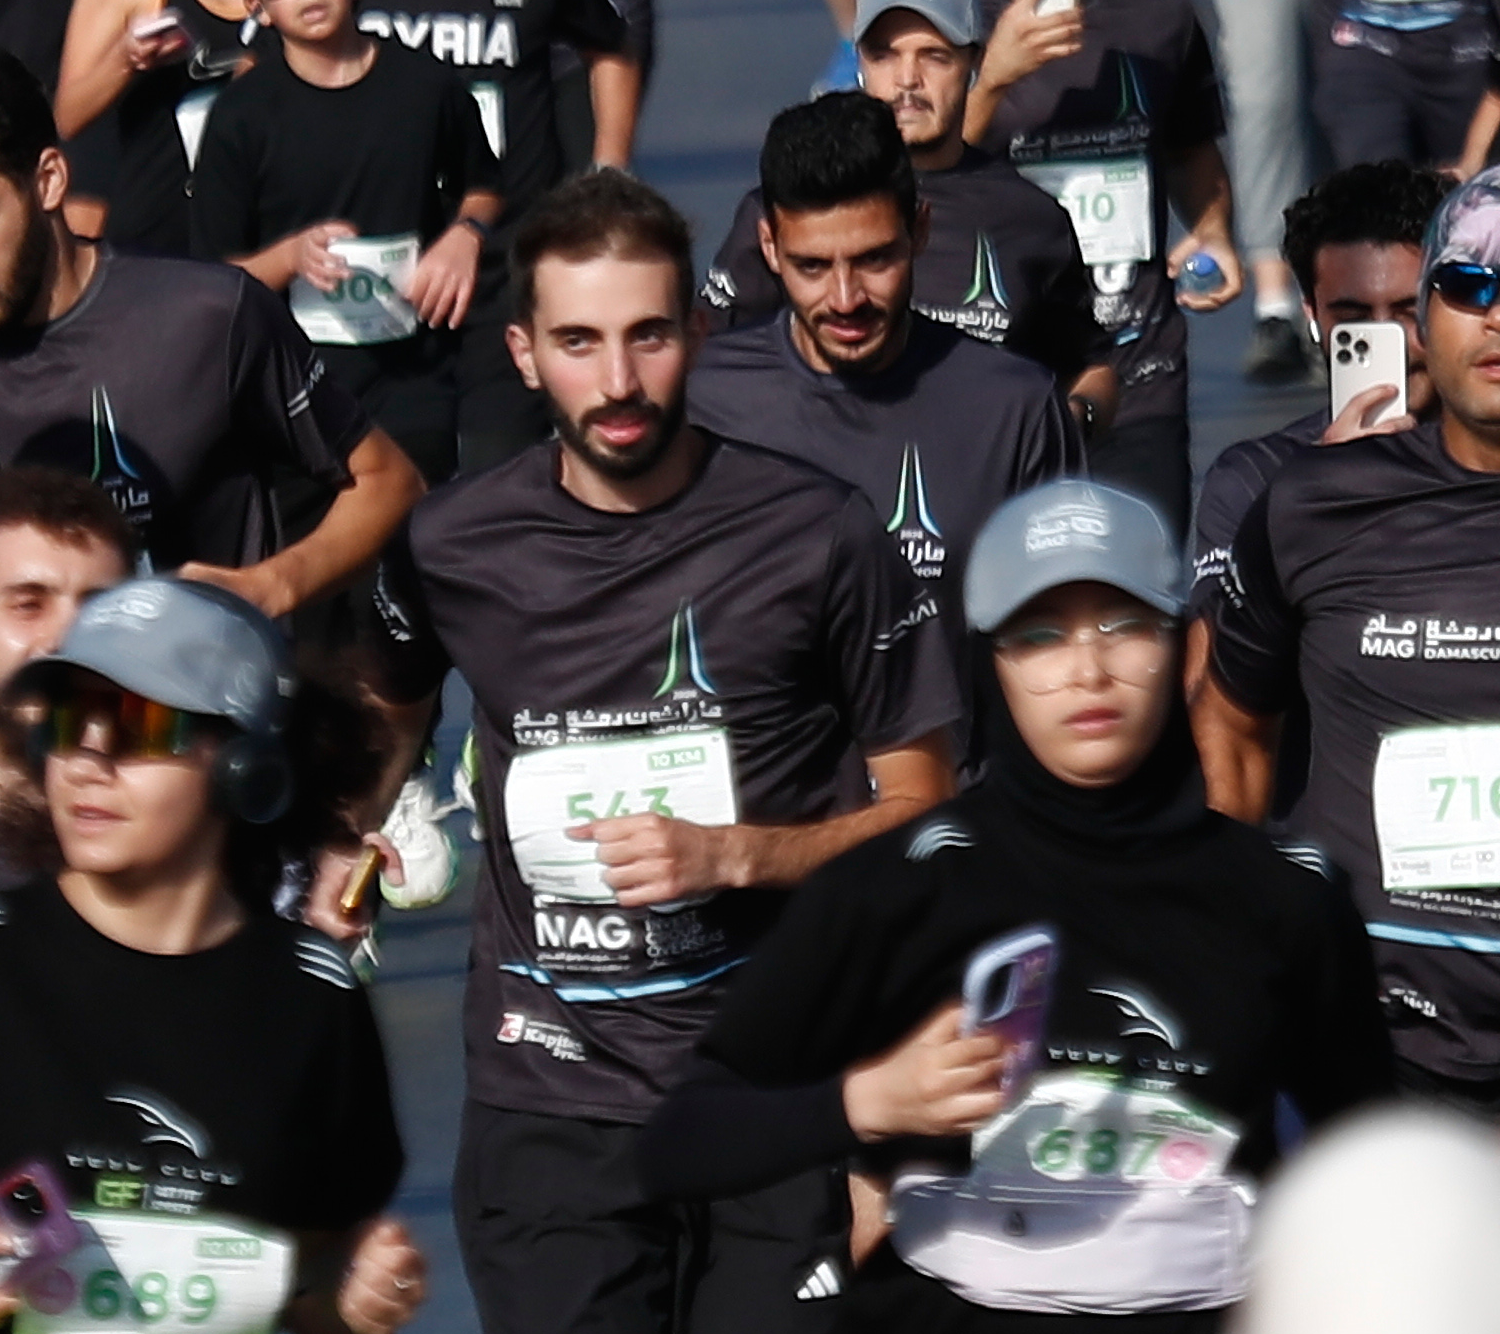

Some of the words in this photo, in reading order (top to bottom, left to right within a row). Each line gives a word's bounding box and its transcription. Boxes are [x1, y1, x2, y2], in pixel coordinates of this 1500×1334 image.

[1056, 193, 1115, 222] 10
[1360, 636, 1416, 659] MAG
[651, 754, 670, 767] 10
[673, 750, 702, 764] KM
[566, 786, 675, 819] 543
[1035, 1128, 1169, 1176] 687
[82, 1269, 217, 1324] 689
